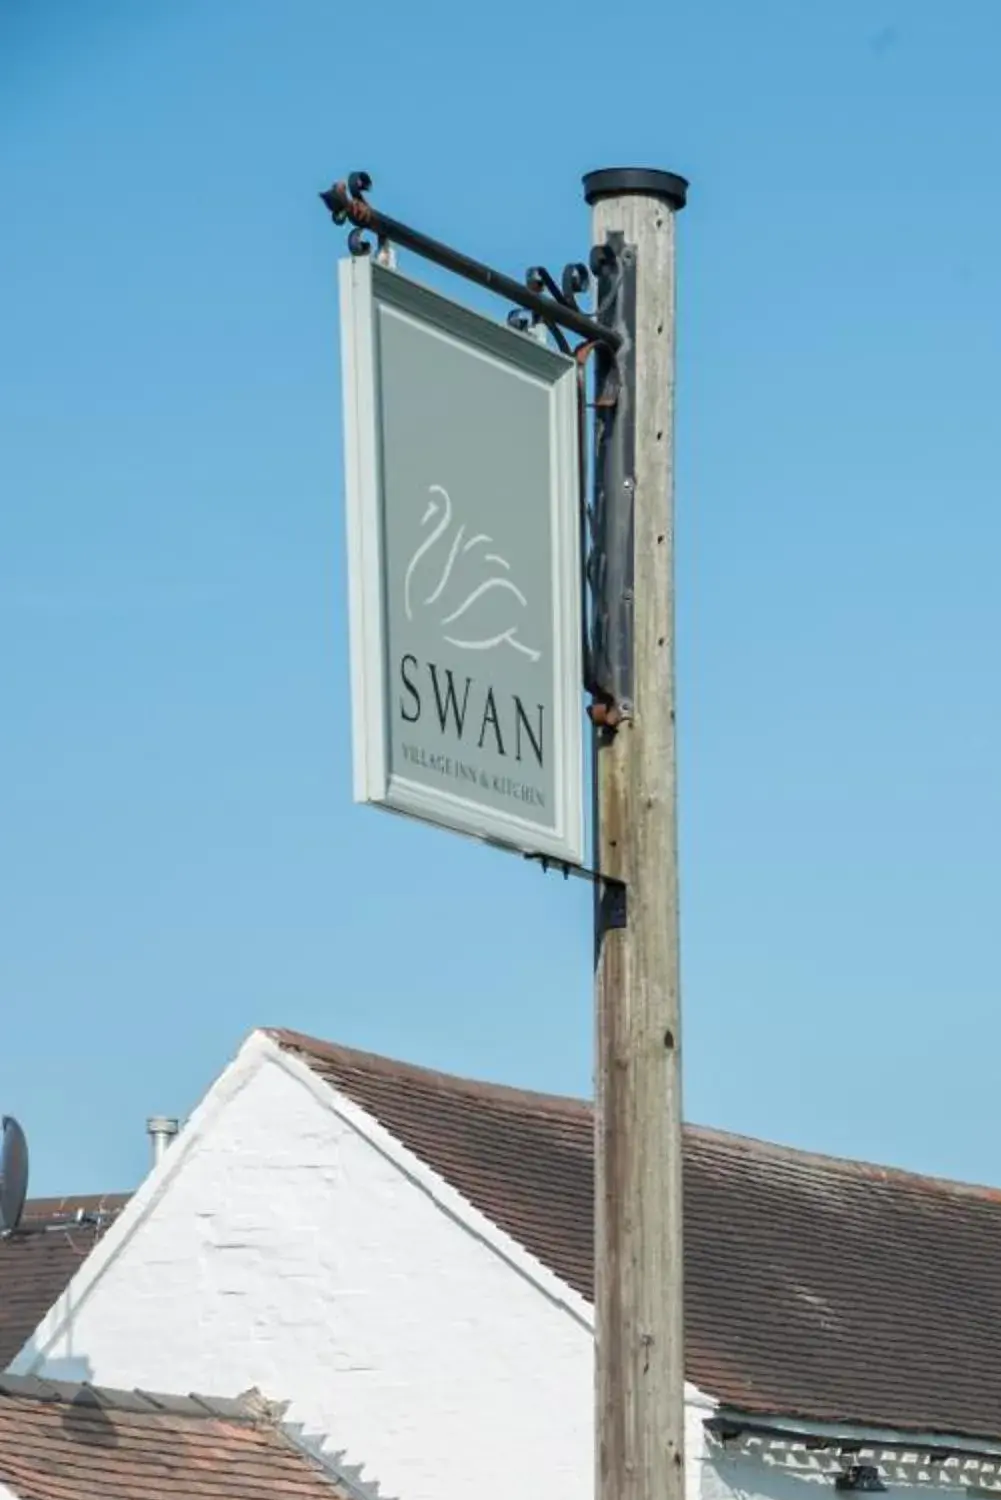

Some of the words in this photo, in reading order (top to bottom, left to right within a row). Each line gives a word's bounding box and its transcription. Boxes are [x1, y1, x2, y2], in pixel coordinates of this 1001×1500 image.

[400, 654, 545, 769] SWAN
[402, 742, 451, 775] VILLAGE
[454, 759, 476, 784] INN
[492, 775, 545, 808] KITCHEN
